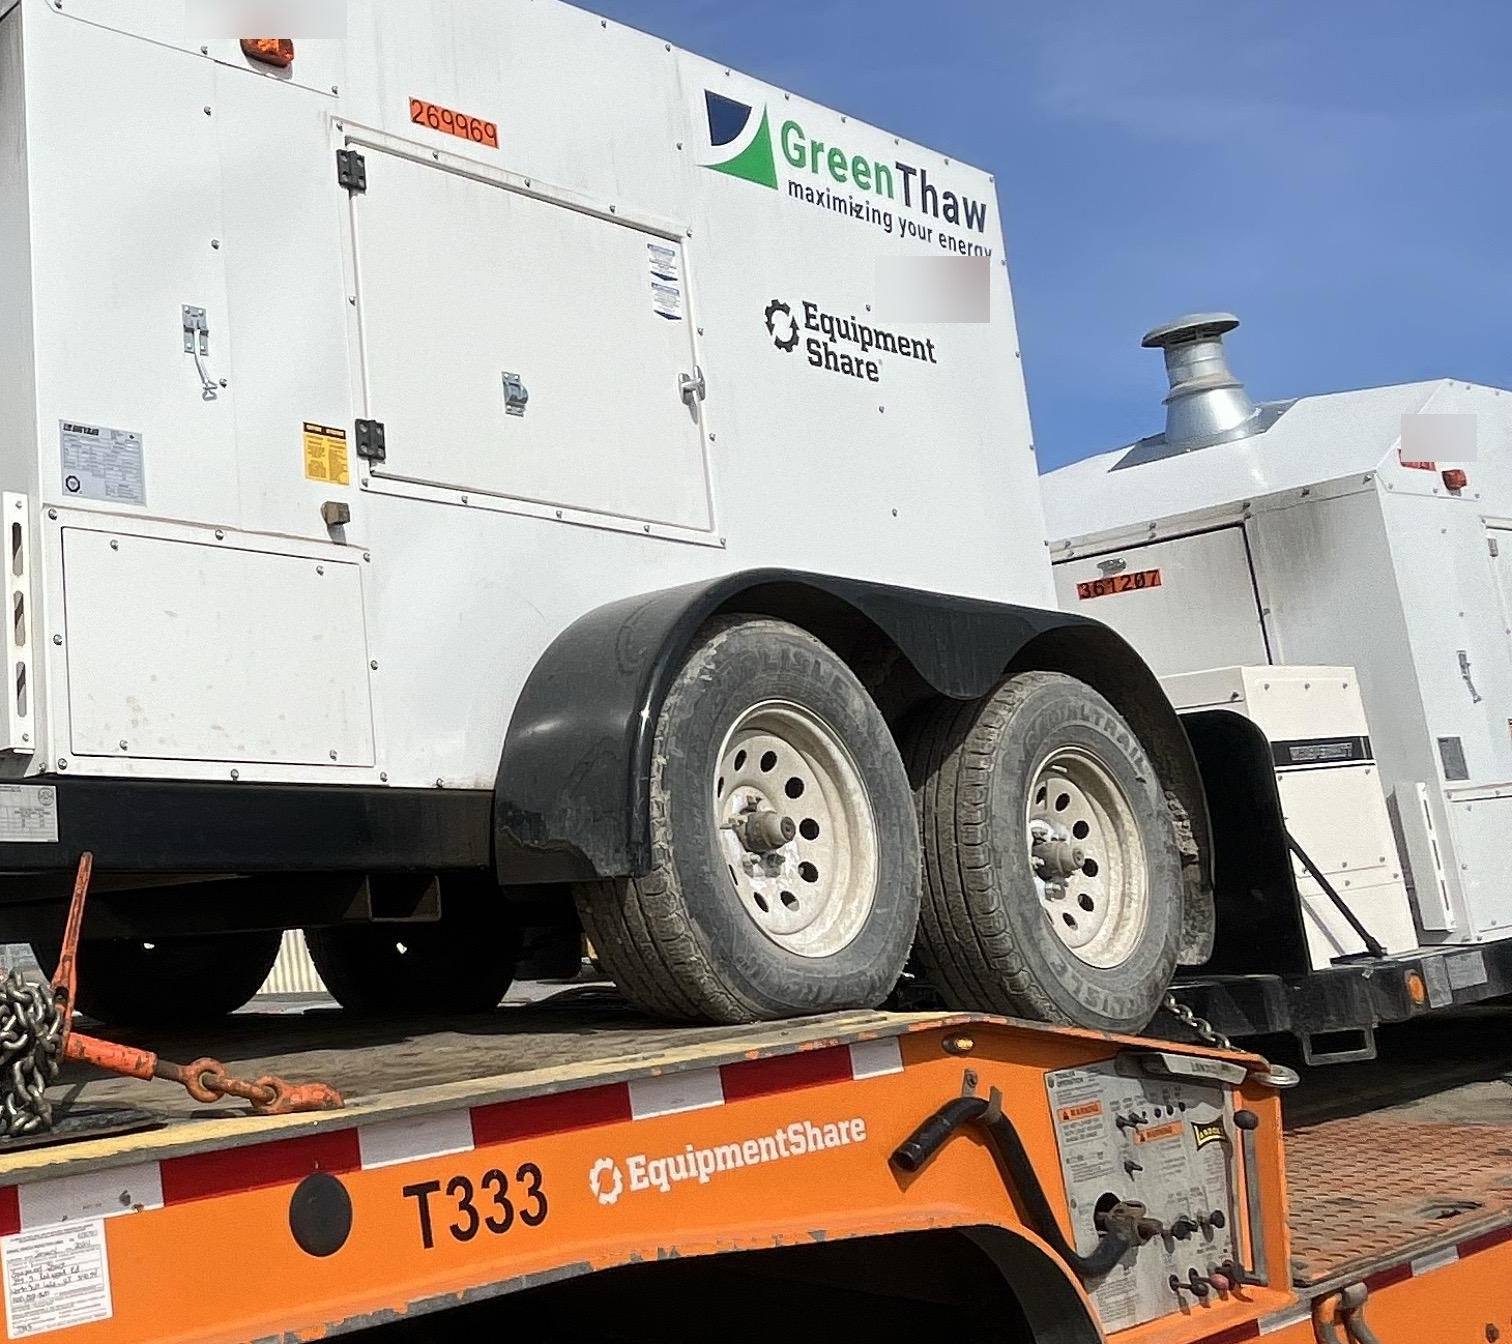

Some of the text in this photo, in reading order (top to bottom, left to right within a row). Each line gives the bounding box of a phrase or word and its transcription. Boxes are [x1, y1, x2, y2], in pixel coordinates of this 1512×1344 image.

[410, 97, 499, 150] 269969
[780, 119, 988, 235] GreenThaw
[787, 178, 894, 234] maximizing
[898, 215, 933, 239] your
[802, 299, 938, 365] Equipment
[806, 336, 880, 383] Share
[1077, 568, 1162, 601] 361207
[625, 1116, 867, 1193] EquipmentShare
[402, 1161, 549, 1250] T333
